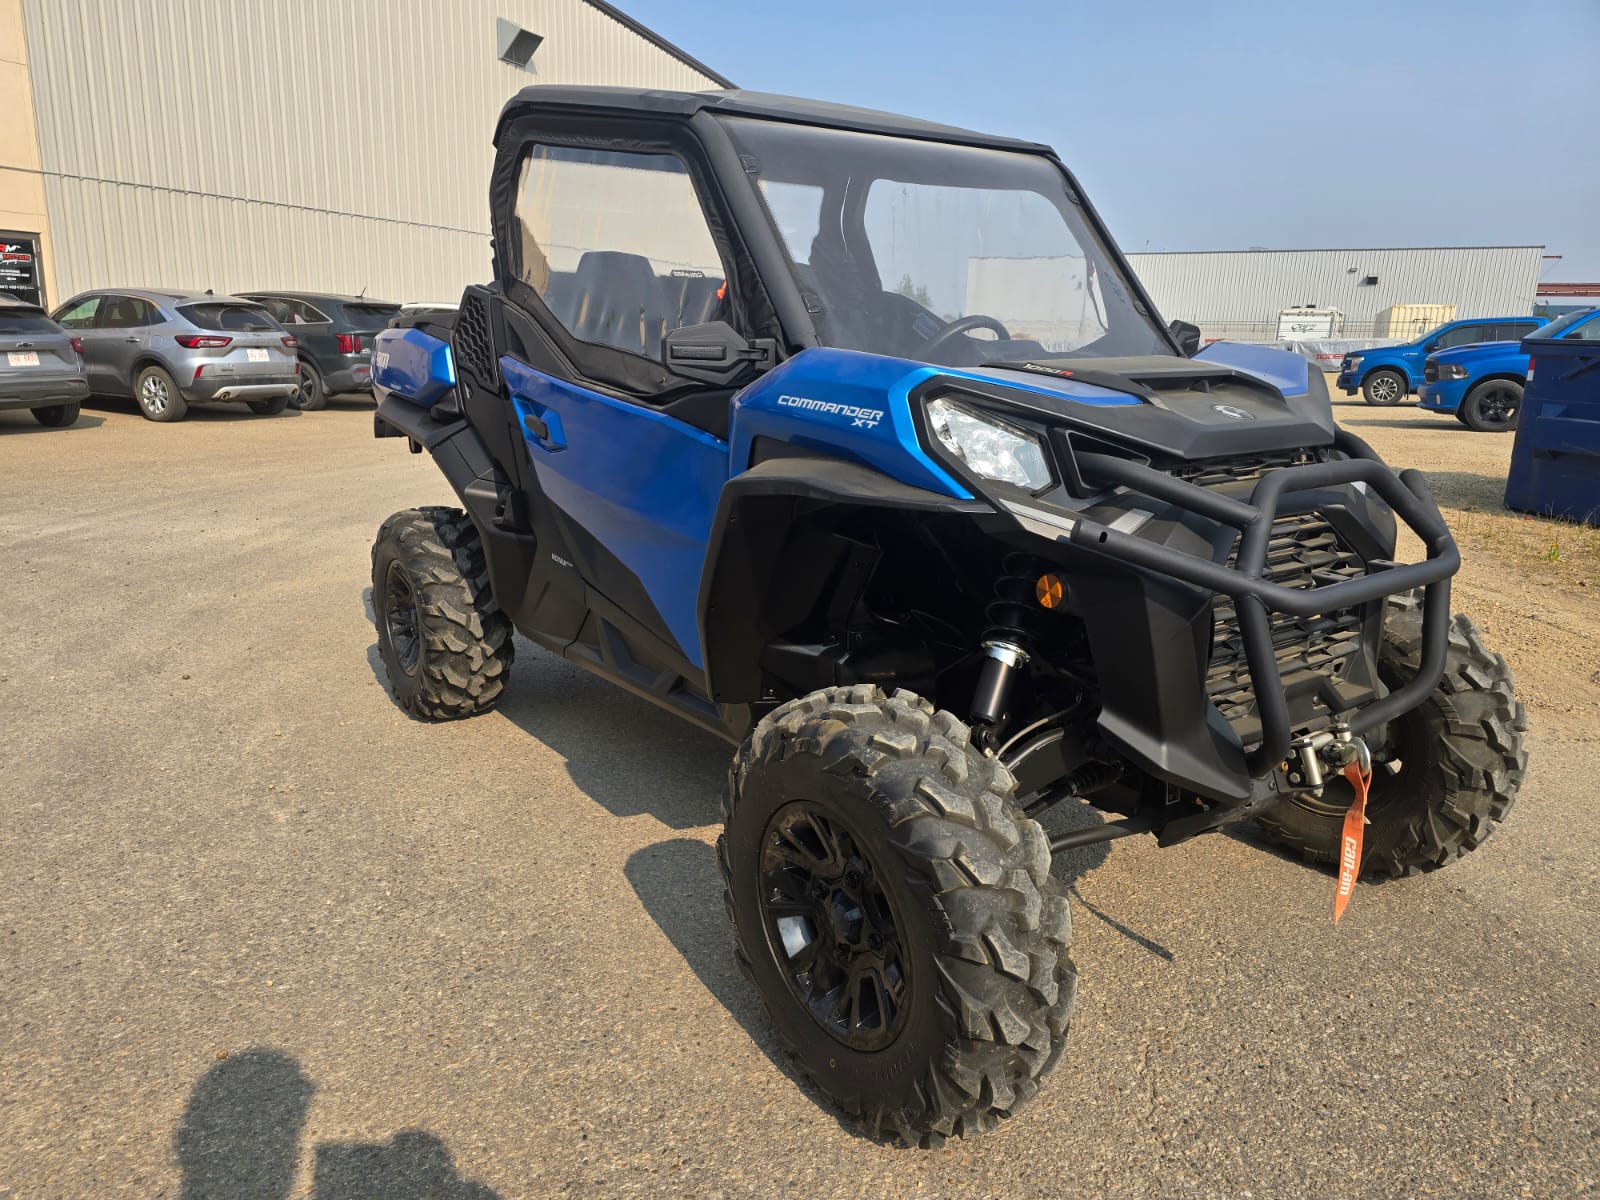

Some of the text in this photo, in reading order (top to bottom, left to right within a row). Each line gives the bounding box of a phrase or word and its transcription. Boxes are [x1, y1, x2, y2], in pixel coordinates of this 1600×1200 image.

[777, 395, 884, 421] COMMANDER
[850, 418, 879, 429] XT
[1340, 836, 1357, 896] can-am
